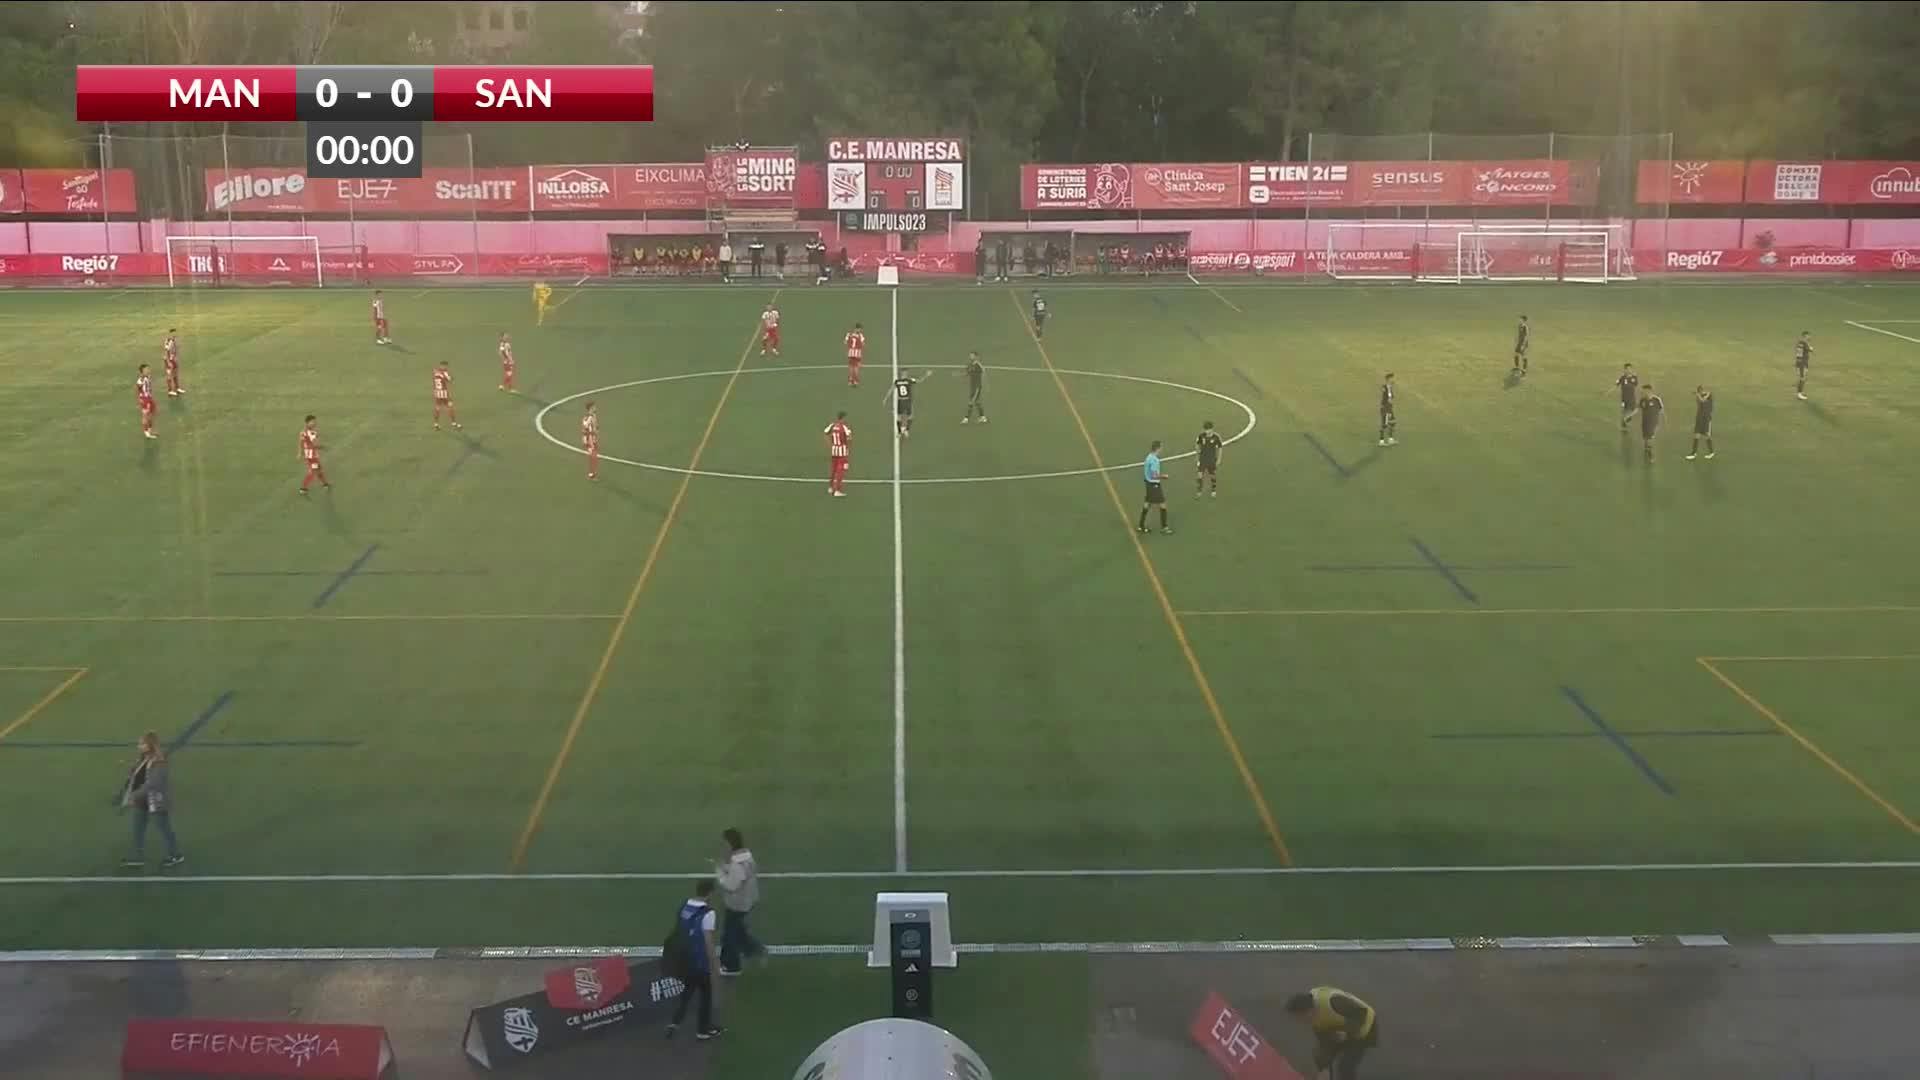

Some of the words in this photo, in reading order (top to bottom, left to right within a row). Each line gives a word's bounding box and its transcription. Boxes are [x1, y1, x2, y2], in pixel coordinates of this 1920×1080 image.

[829, 141, 864, 159] C.E.
[866, 141, 961, 160] MANRESA
[748, 158, 795, 174] MINA
[1268, 166, 1308, 180] TIEN
[635, 168, 706, 183] EIXCLIMA
[748, 175, 795, 192] SORT
[1372, 171, 1443, 184] sensus
[338, 179, 397, 198] EJE7
[537, 182, 610, 194] INLLOBSA
[1164, 181, 1190, 192] Sant
[1193, 181, 1225, 193] Josep
[62, 255, 118, 274] Regió7
[1668, 251, 1722, 268] Regió7
[566, 1015, 581, 1026] CE
[583, 1001, 634, 1021] MANRESA
[1211, 1008, 1260, 1064] EJE7
